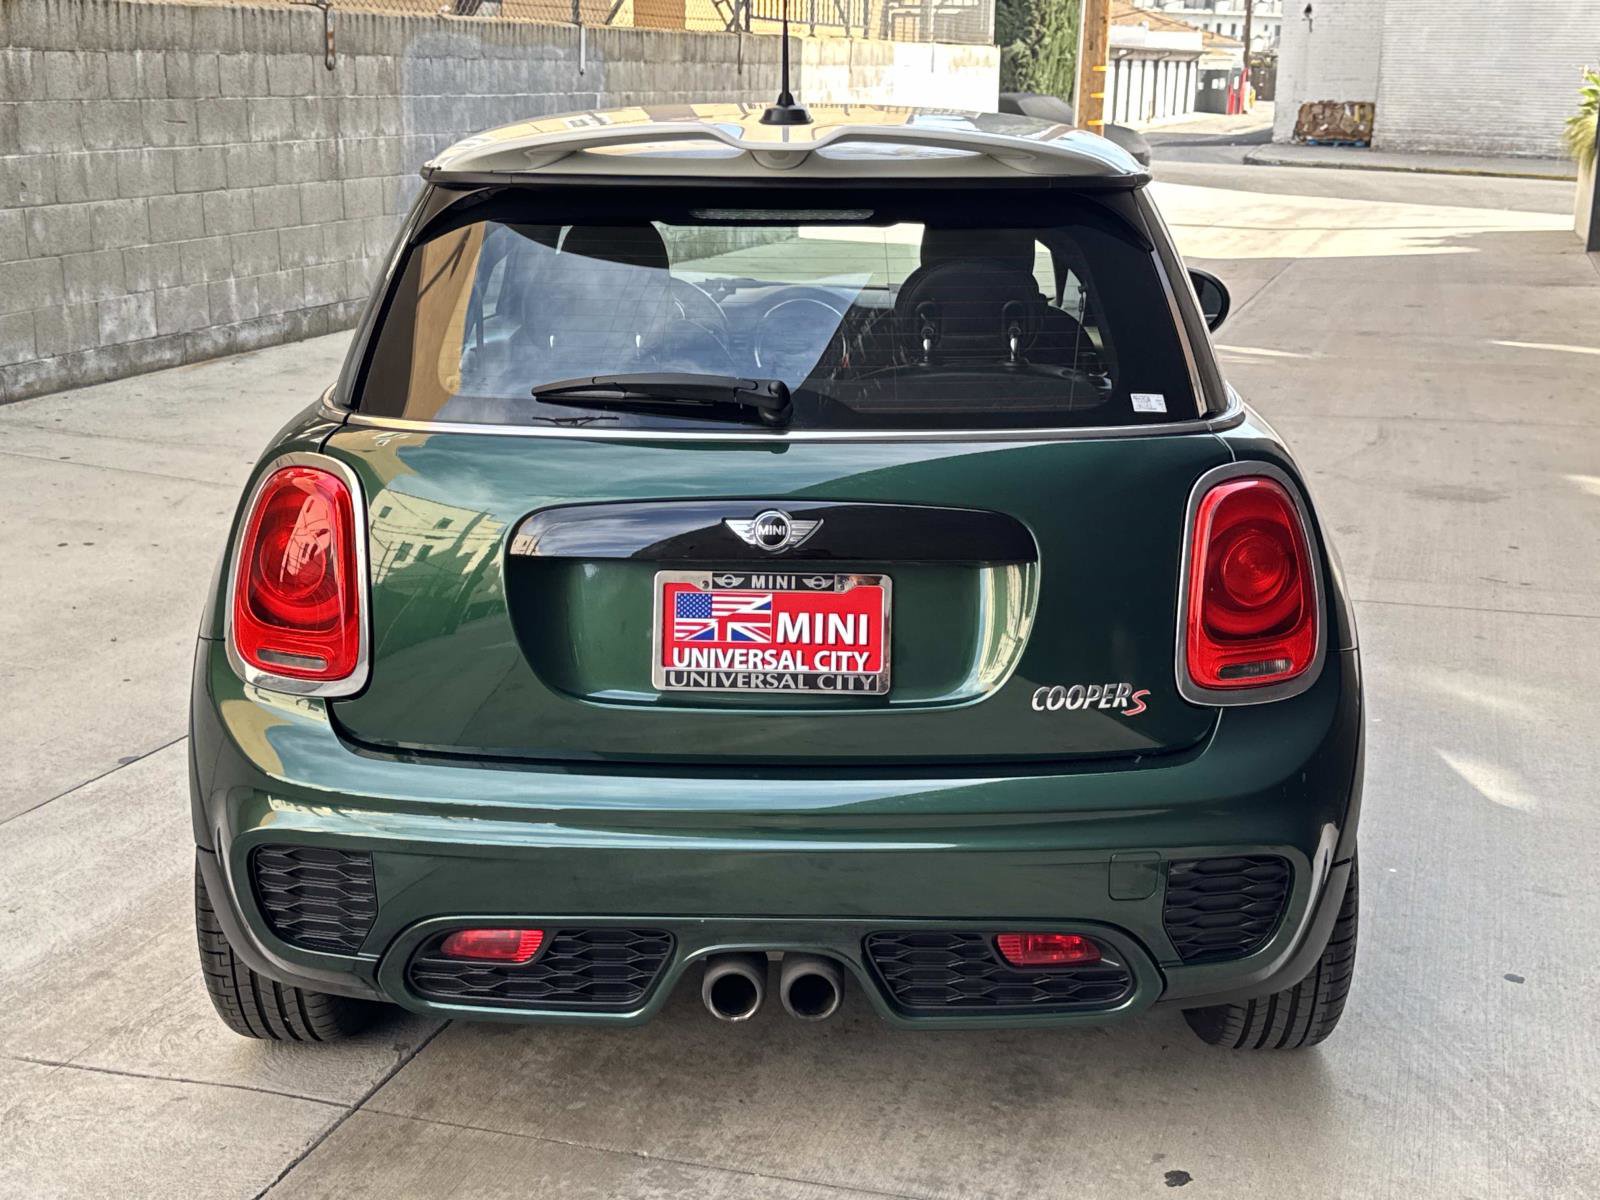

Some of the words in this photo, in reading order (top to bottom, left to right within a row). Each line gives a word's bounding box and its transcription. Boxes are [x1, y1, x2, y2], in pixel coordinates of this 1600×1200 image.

[759, 524, 786, 536] MINI
[751, 575, 797, 590] MINI
[776, 612, 869, 645] MINI
[672, 647, 810, 671] UNIVERSAL
[814, 651, 870, 672] CITY
[669, 672, 810, 689] UNIVERSAL
[816, 674, 877, 690] CITY
[1031, 682, 1133, 711] COOPER
[1120, 689, 1151, 716] S
